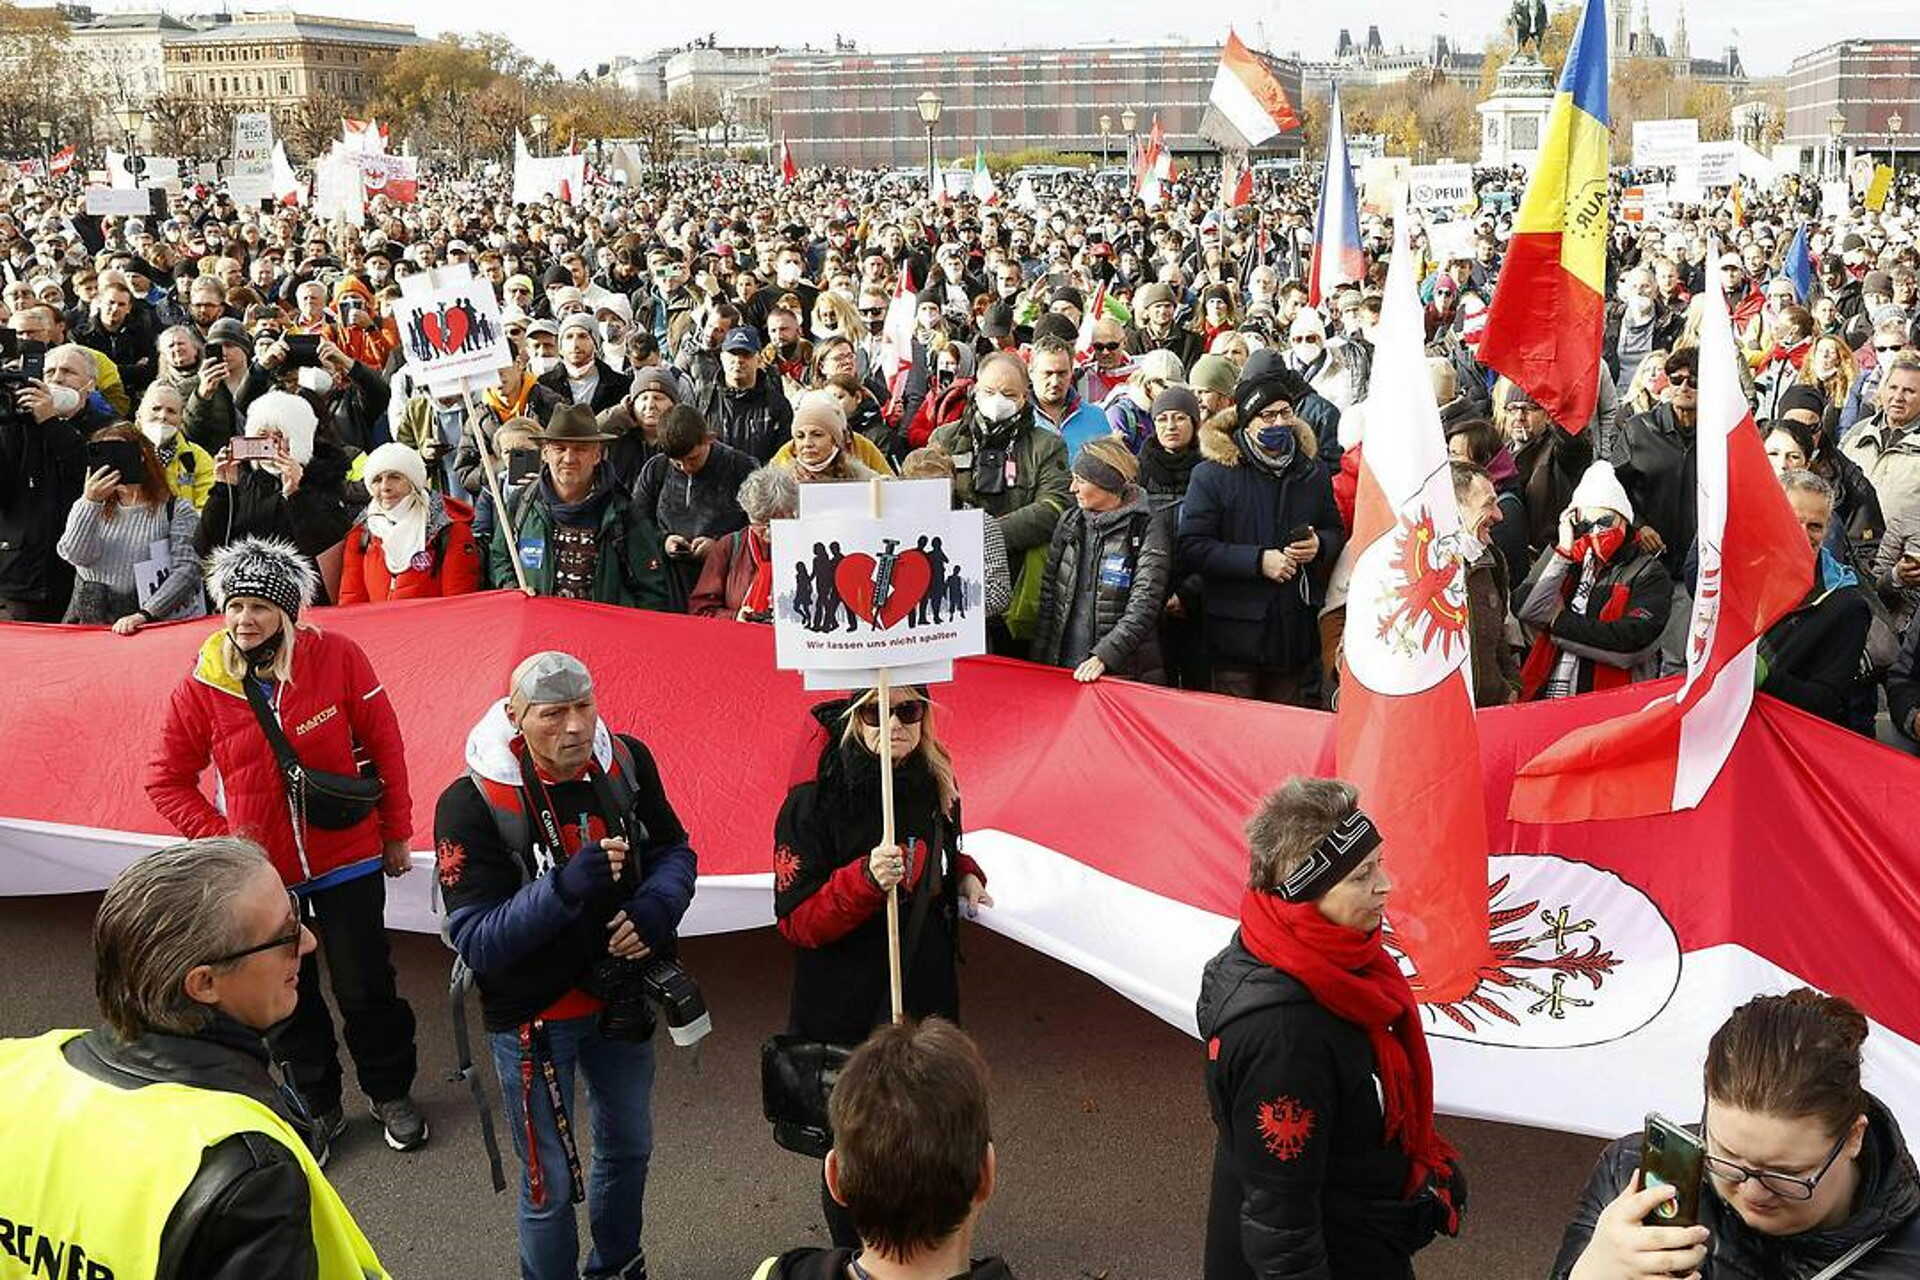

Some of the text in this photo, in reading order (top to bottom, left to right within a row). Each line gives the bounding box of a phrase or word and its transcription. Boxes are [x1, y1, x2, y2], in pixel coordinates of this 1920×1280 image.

[807, 632, 958, 649] Wir lassen uns nicht spalten
[541, 809, 560, 847] Canon
